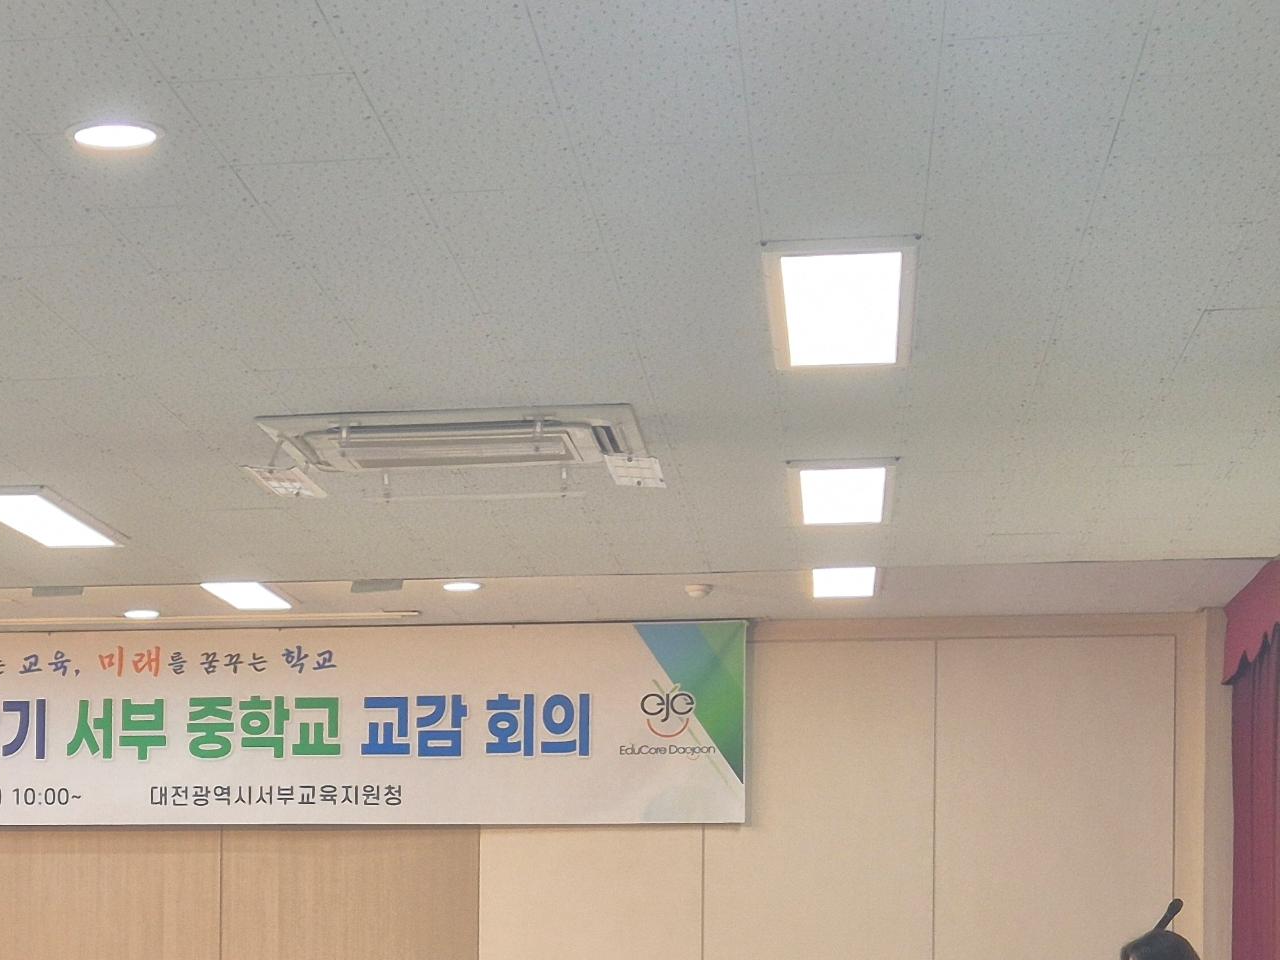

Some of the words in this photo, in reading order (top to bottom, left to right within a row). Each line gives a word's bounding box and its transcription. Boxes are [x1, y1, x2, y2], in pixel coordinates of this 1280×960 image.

[18, 650, 80, 677] 교육,
[98, 646, 187, 677] 미래를
[199, 652, 268, 675] 꿈꾸는
[281, 645, 337, 674] 학교
[68, 699, 167, 760] 서부
[187, 697, 340, 758] 중학교
[361, 695, 468, 757] 교감
[486, 693, 590, 757] 회의
[12, 788, 82, 805] 10:00~
[150, 784, 403, 806] 대전광역시서부교육지원청
